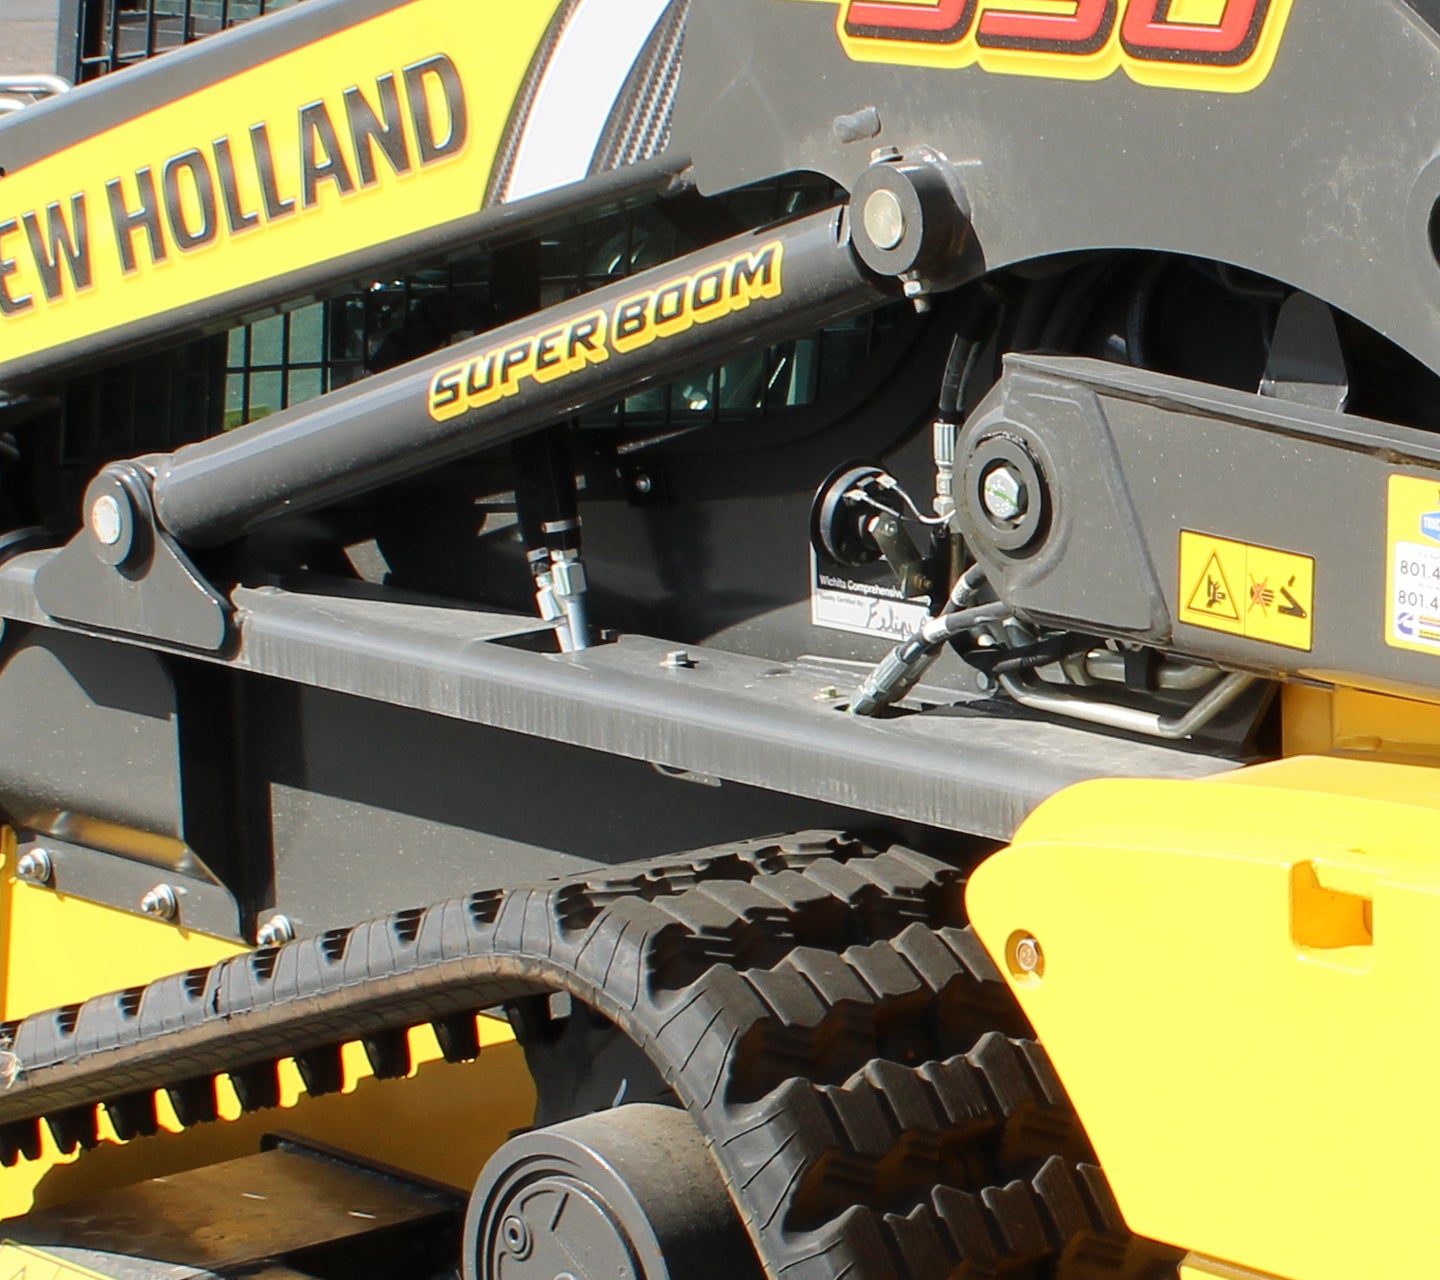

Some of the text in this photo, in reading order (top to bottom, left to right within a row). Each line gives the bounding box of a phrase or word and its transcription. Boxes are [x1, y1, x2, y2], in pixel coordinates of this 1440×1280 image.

[105, 52, 469, 275] HOLLAND
[430, 242, 781, 418] SUPER BOOM
[819, 574, 847, 590] Wichita
